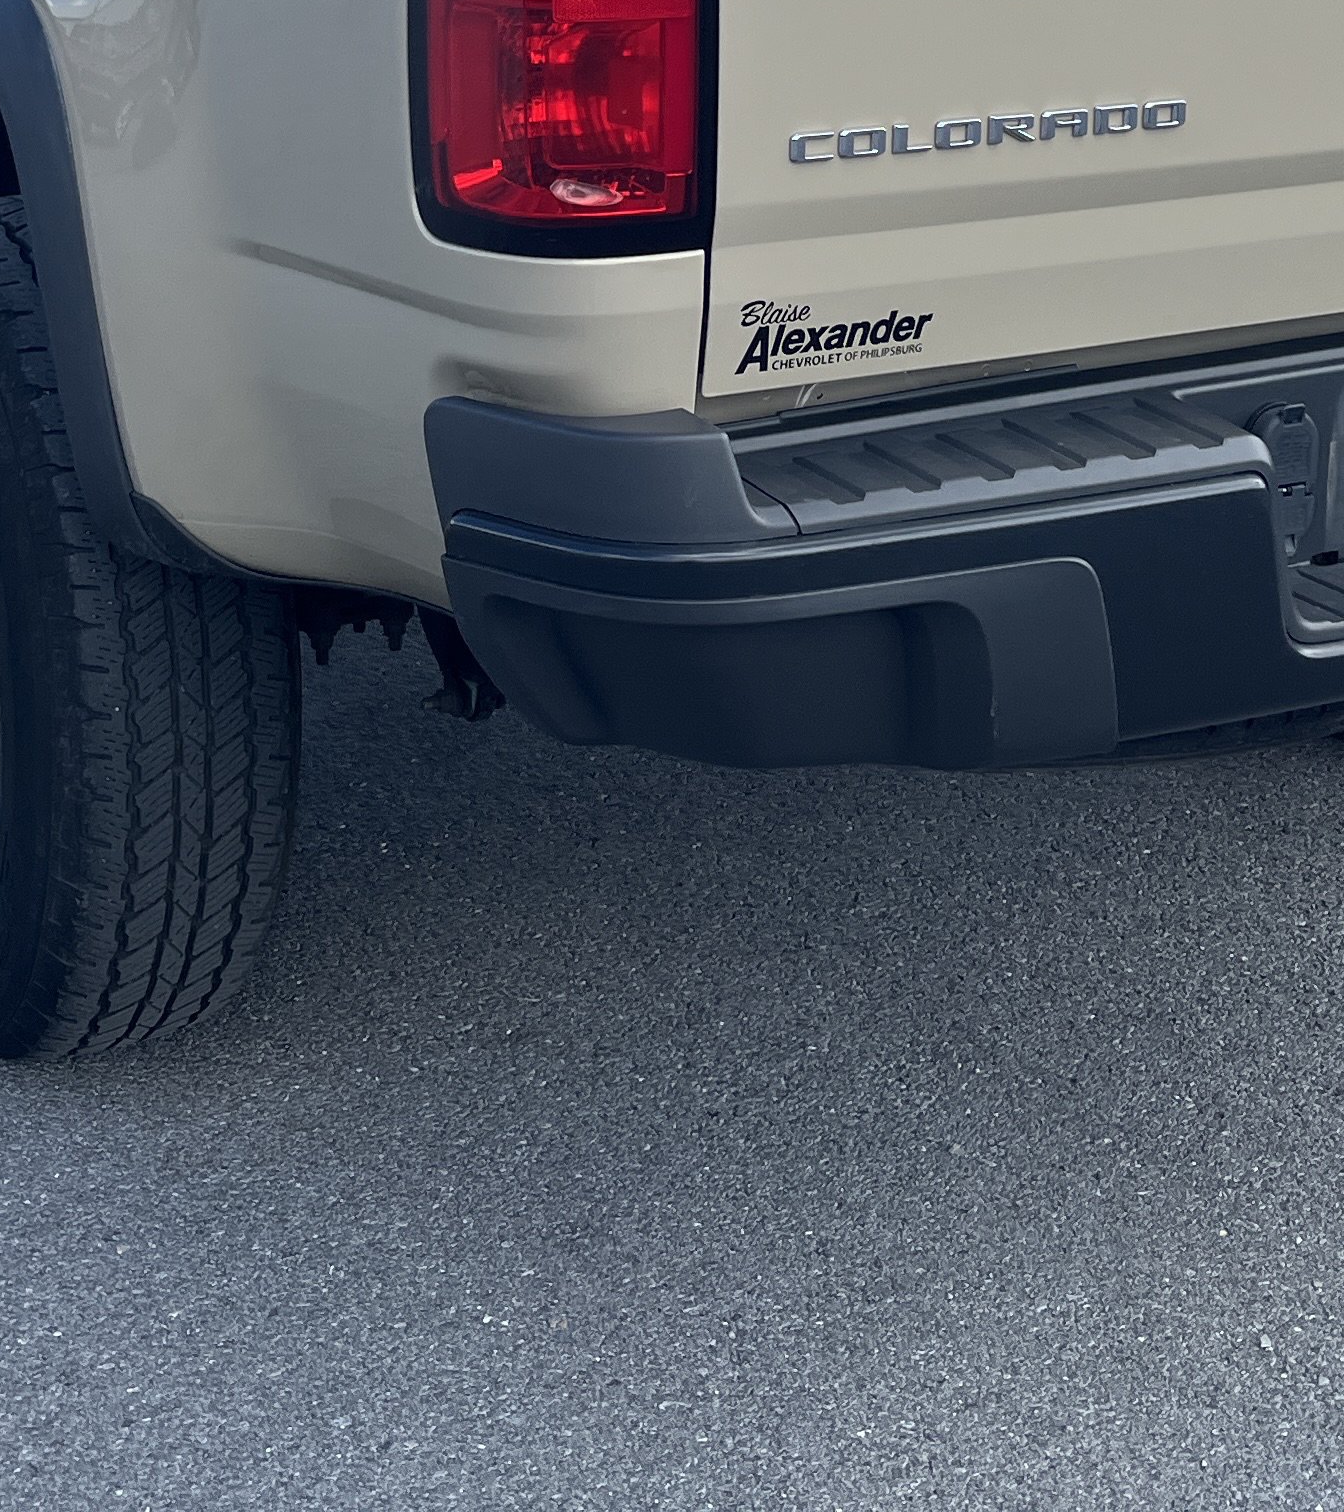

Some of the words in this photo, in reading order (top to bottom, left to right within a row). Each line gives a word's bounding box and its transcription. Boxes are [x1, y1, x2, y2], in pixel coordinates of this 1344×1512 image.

[788, 99, 1187, 164] COLORADO
[741, 300, 811, 327] Blaise
[734, 310, 934, 375] Alexander
[771, 352, 842, 371] CHEVROLET
[844, 350, 858, 362] OF
[860, 343, 923, 360] PHILIPSBURG
